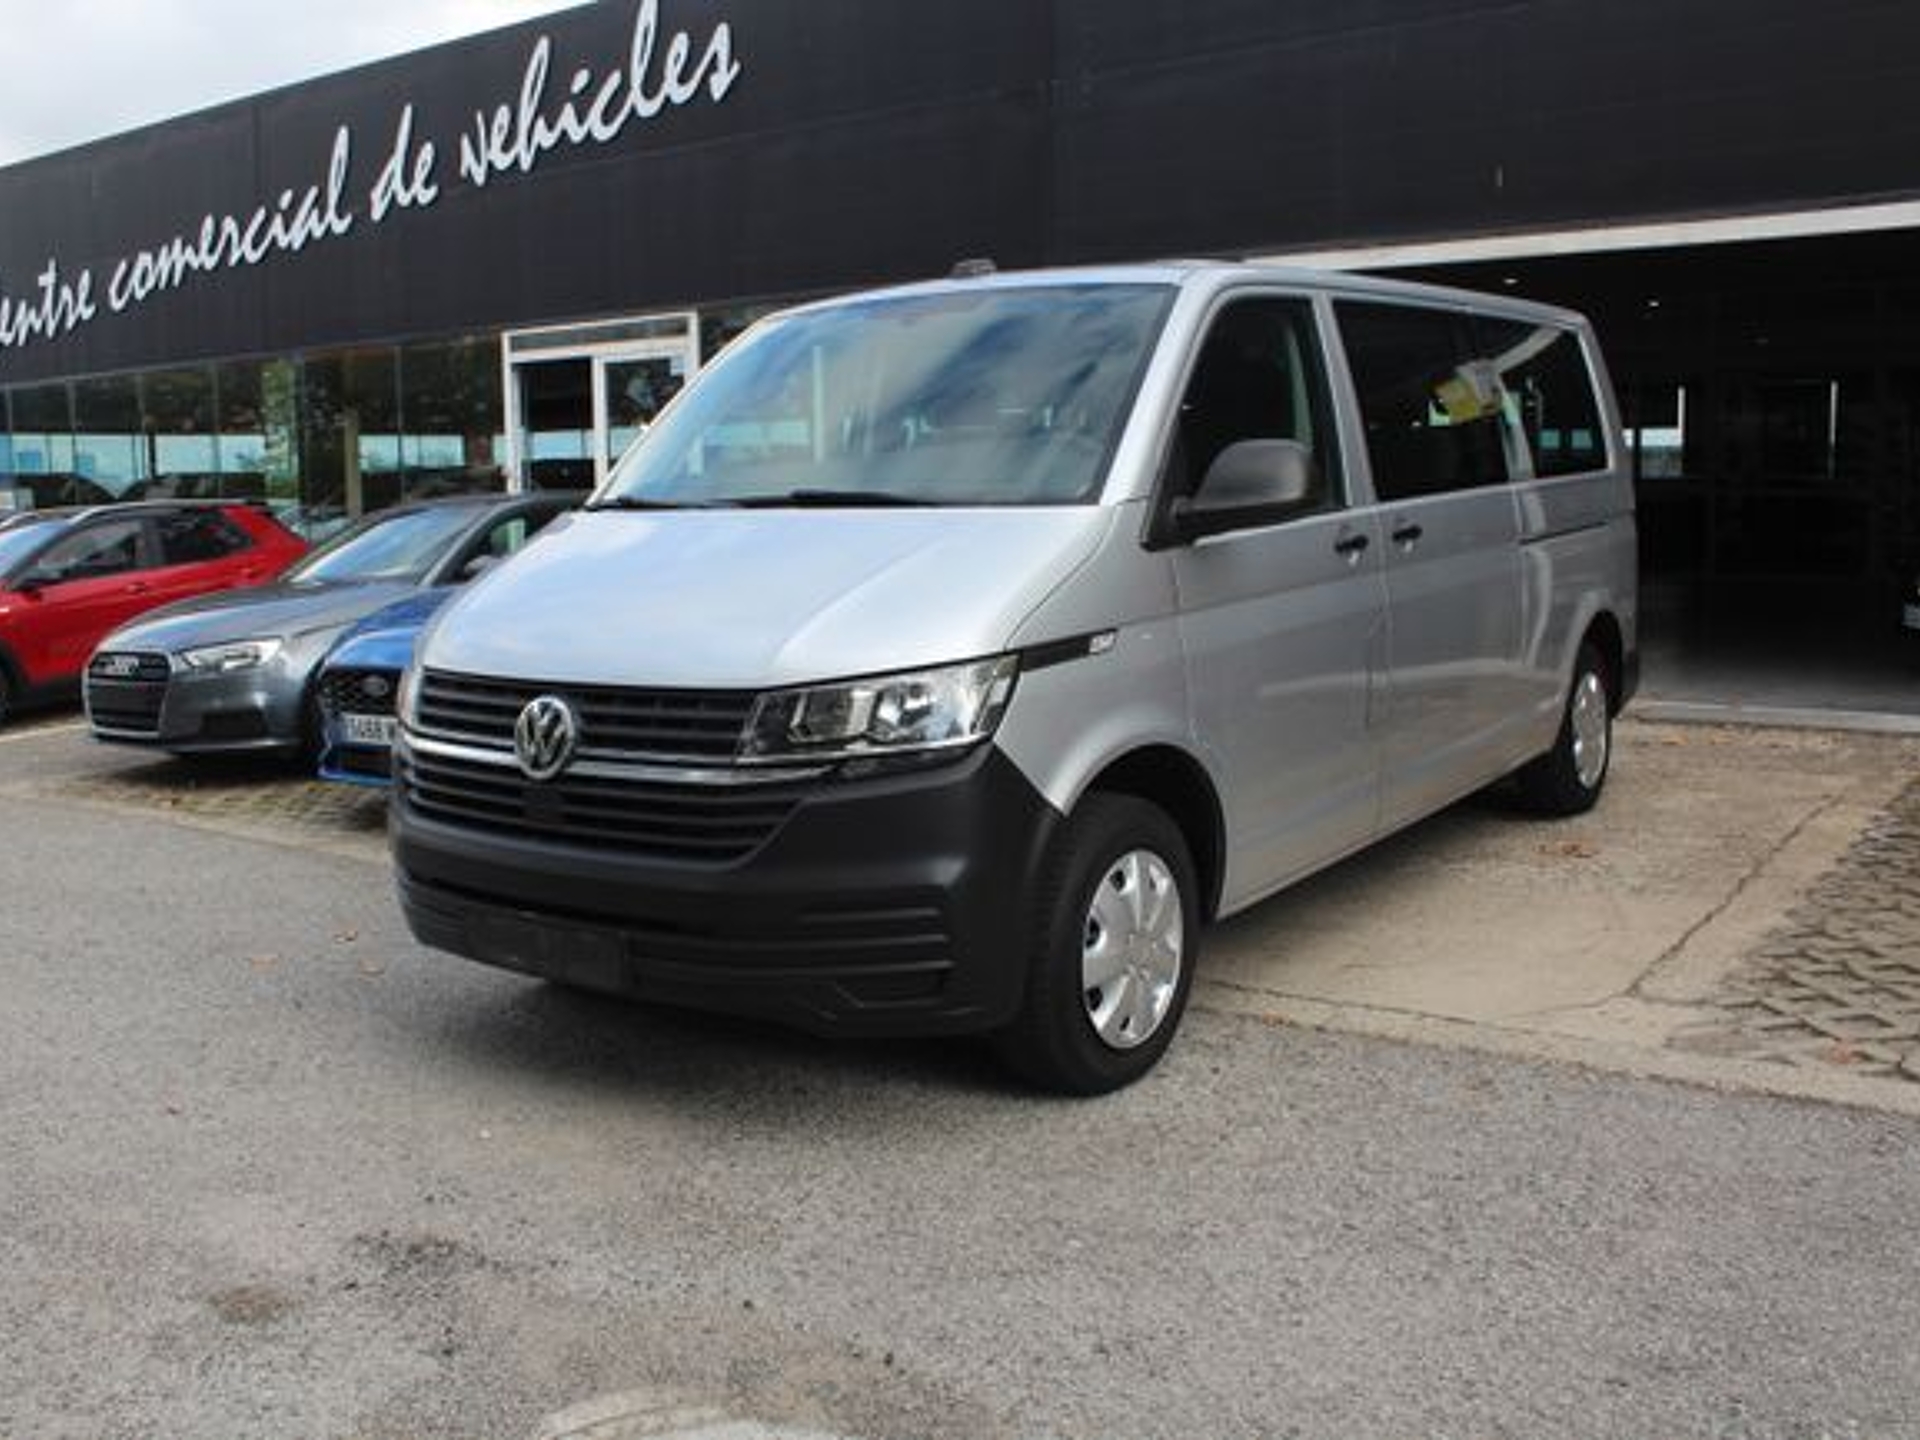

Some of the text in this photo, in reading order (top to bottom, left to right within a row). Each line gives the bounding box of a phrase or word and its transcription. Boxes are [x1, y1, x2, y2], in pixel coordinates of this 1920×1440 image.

[109, 125, 354, 312] comercial
[370, 103, 438, 221] de
[460, 0, 741, 187] vehicles
